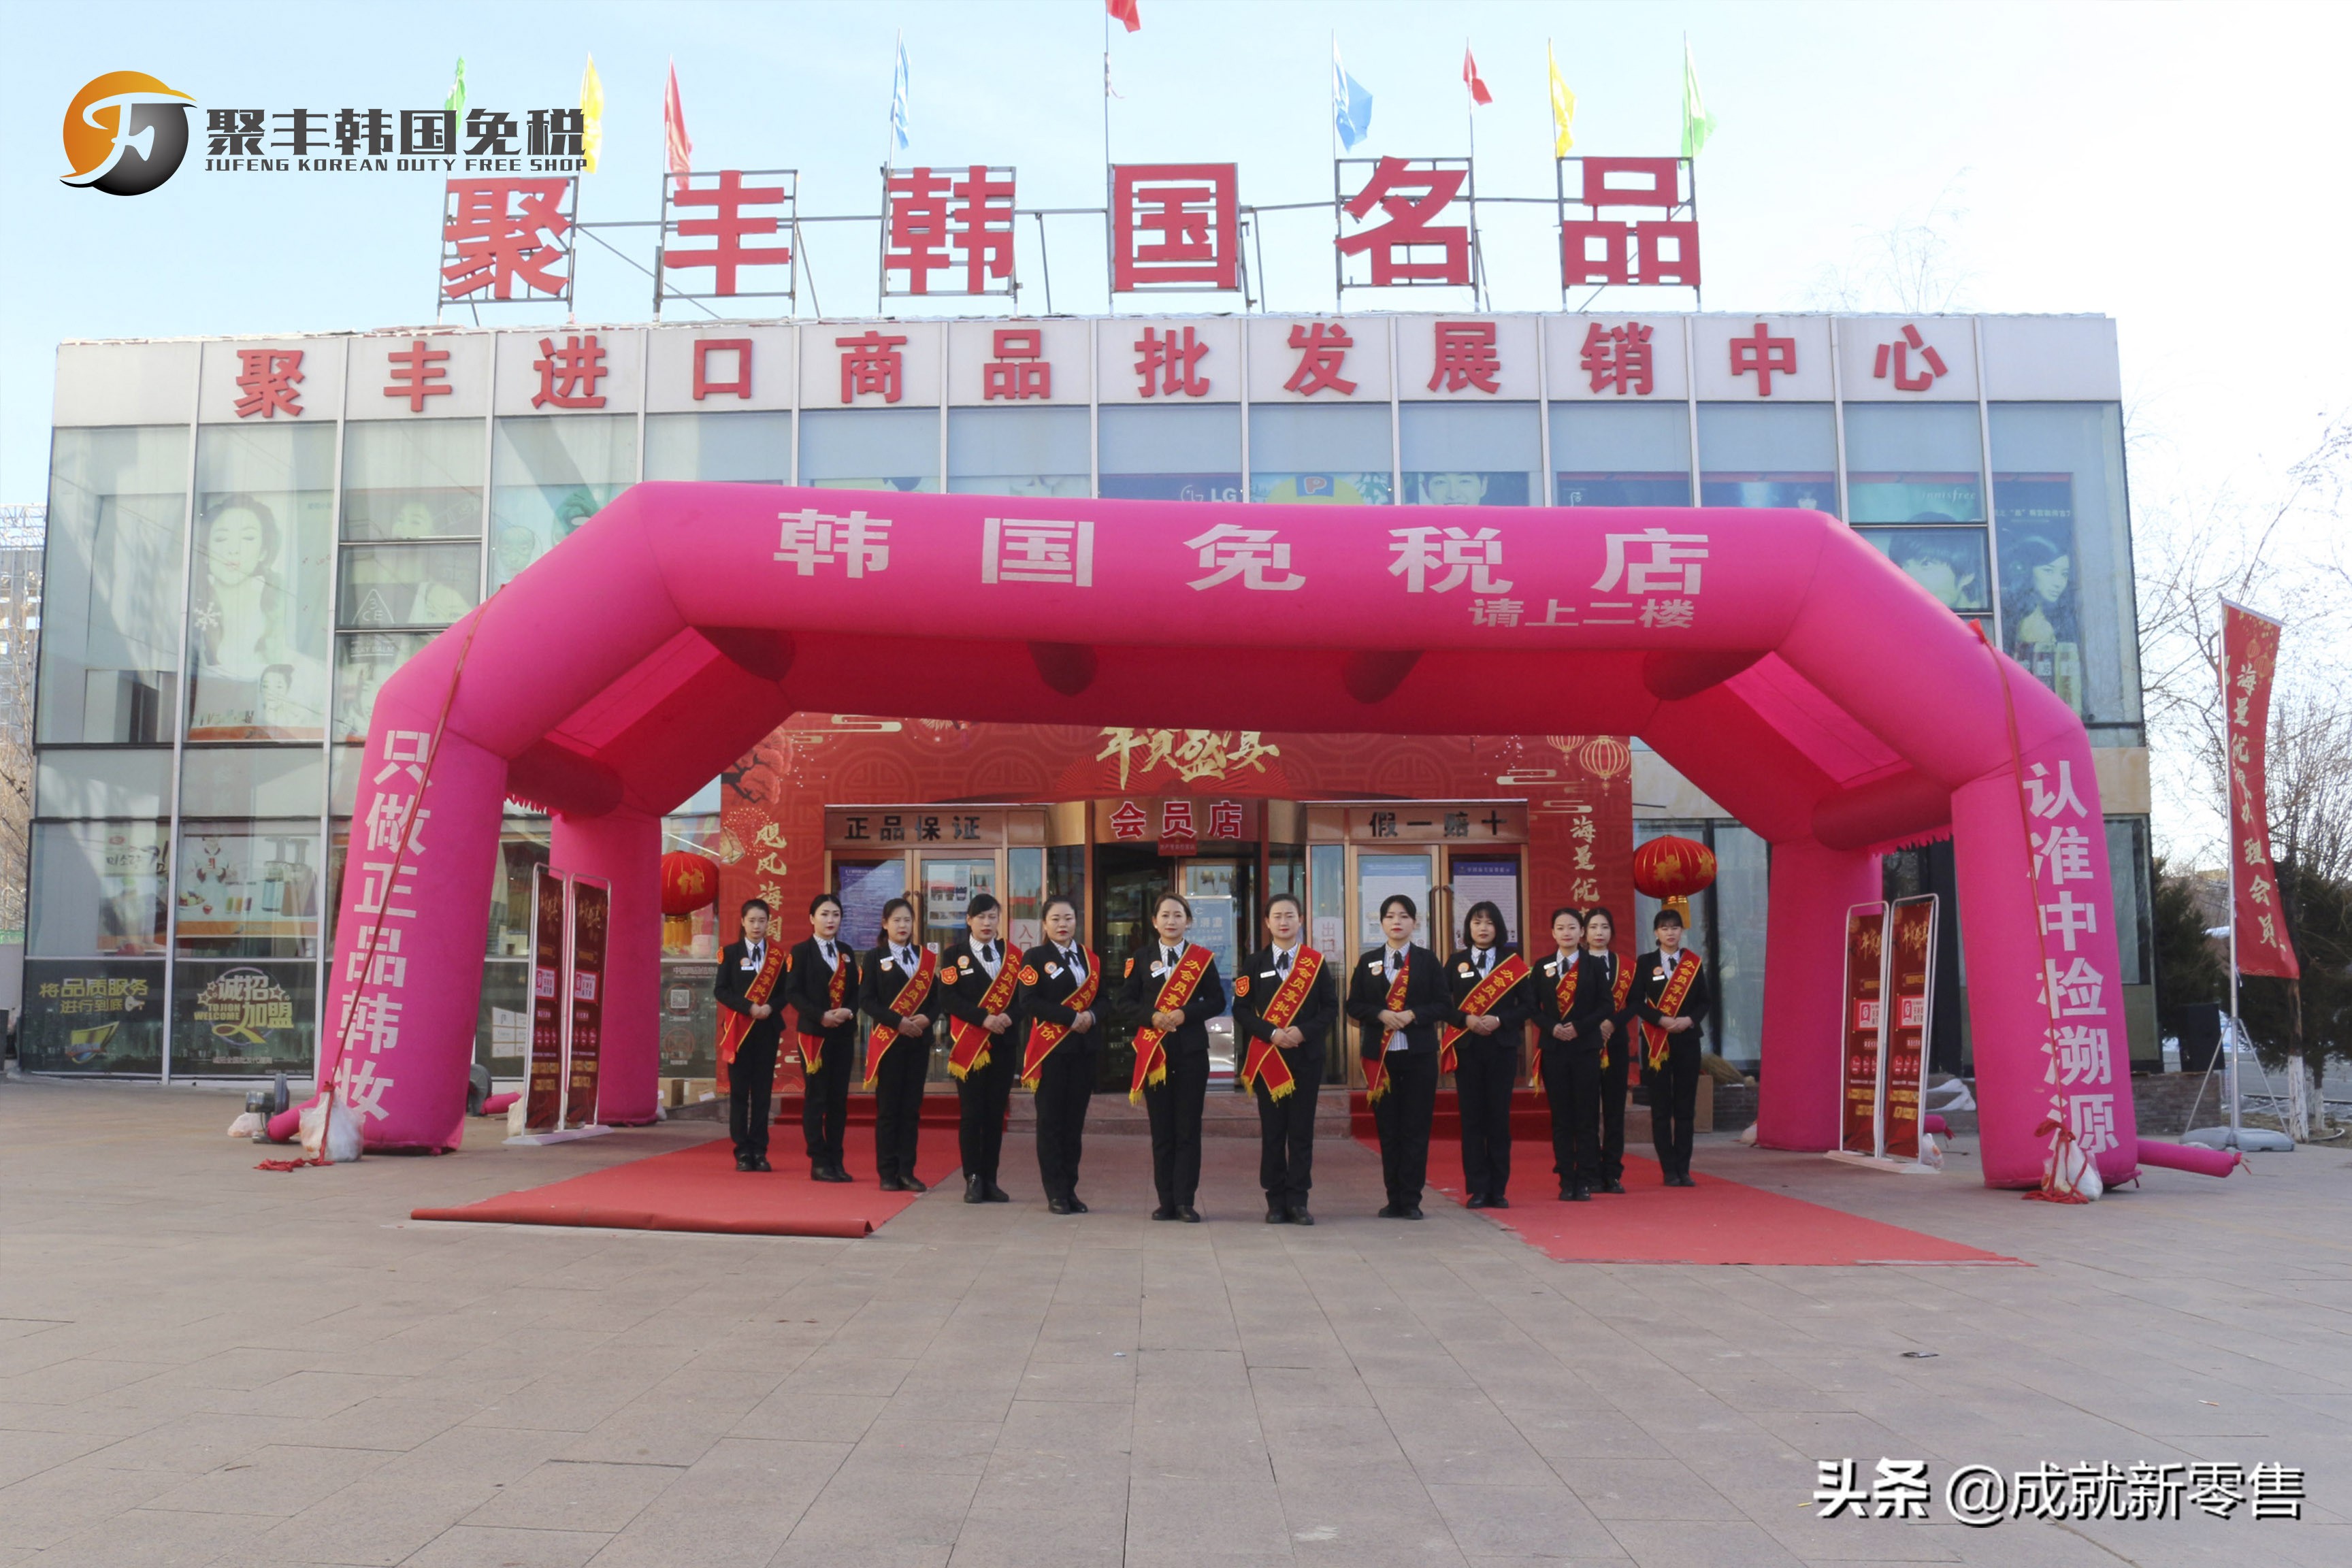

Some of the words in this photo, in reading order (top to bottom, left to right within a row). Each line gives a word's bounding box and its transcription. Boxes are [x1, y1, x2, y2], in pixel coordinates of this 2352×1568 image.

[439, 155, 1700, 299] 聚丰韩国名品
[234, 321, 1948, 419] 聚丰进口商品批发展销中心
[1211, 488, 1237, 502] LG
[1922, 487, 1976, 505] innisfree
[773, 508, 1710, 595] 韩国免税店
[1468, 598, 1695, 629] 请上二楼
[845, 815, 981, 841] 正品保证
[1109, 800, 1243, 838] 会员店
[1369, 811, 1507, 837] 假一赔十
[332, 730, 432, 1121] 只做正品韩妆
[1322, 921, 1336, 953] 出口
[2023, 760, 2120, 1155] 认准中检溯源
[39, 978, 149, 998] 将品质服务
[218, 975, 269, 1001] 诚招
[60, 998, 123, 1013] 进行到底
[194, 1012, 240, 1020] WELCOME
[242, 1001, 294, 1028] 加盟
